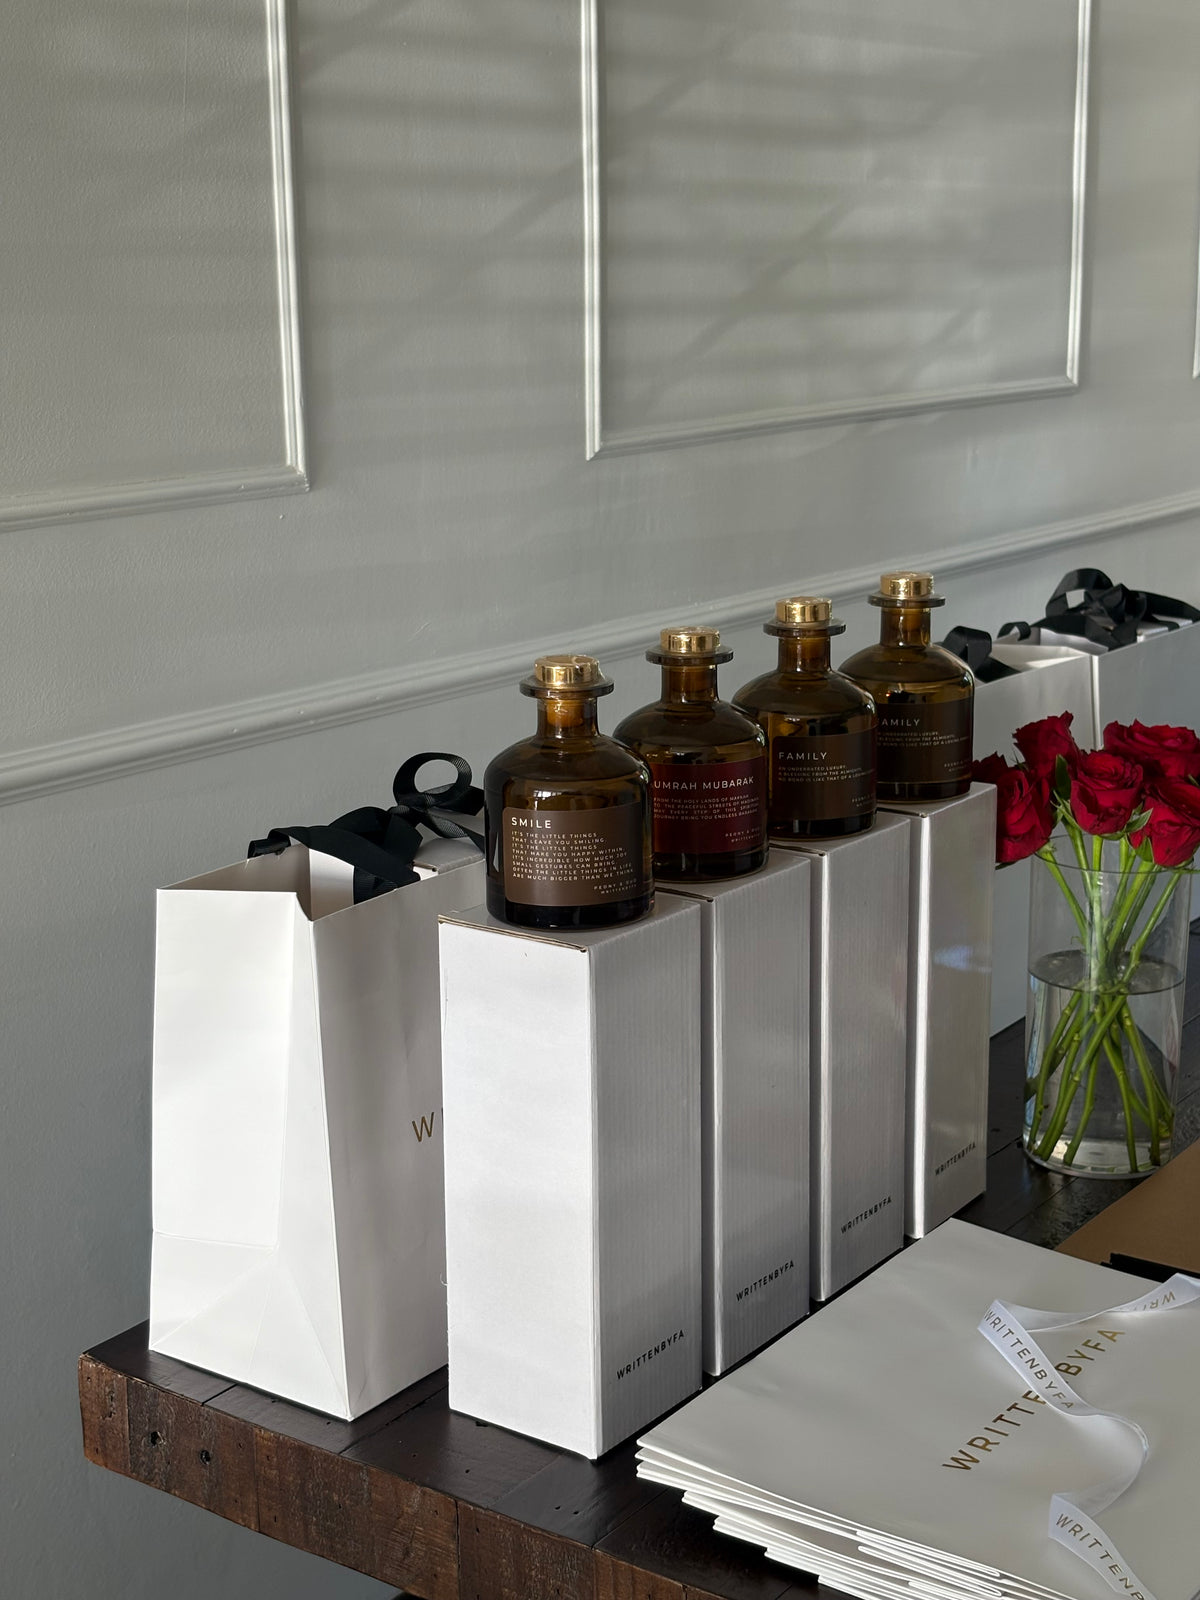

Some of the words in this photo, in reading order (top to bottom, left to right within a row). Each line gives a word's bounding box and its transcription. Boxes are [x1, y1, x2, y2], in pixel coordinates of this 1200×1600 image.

[878, 718, 920, 727] AMILY
[778, 752, 827, 760] FAMILY
[654, 780, 697, 790] UMRAH
[702, 776, 754, 790] MUBARAK
[511, 817, 552, 829] SMILE
[412, 1107, 443, 1142] W
[935, 1141, 976, 1176] WRITTENBYFA
[840, 1195, 892, 1234] WRITTENBYFA
[736, 1260, 795, 1302] WRITTENBYFA
[616, 1329, 685, 1380] WRITTENBYFA
[984, 1311, 1074, 1410] WRITTENBYFA
[942, 1328, 1125, 1471] WRITTEBYFA
